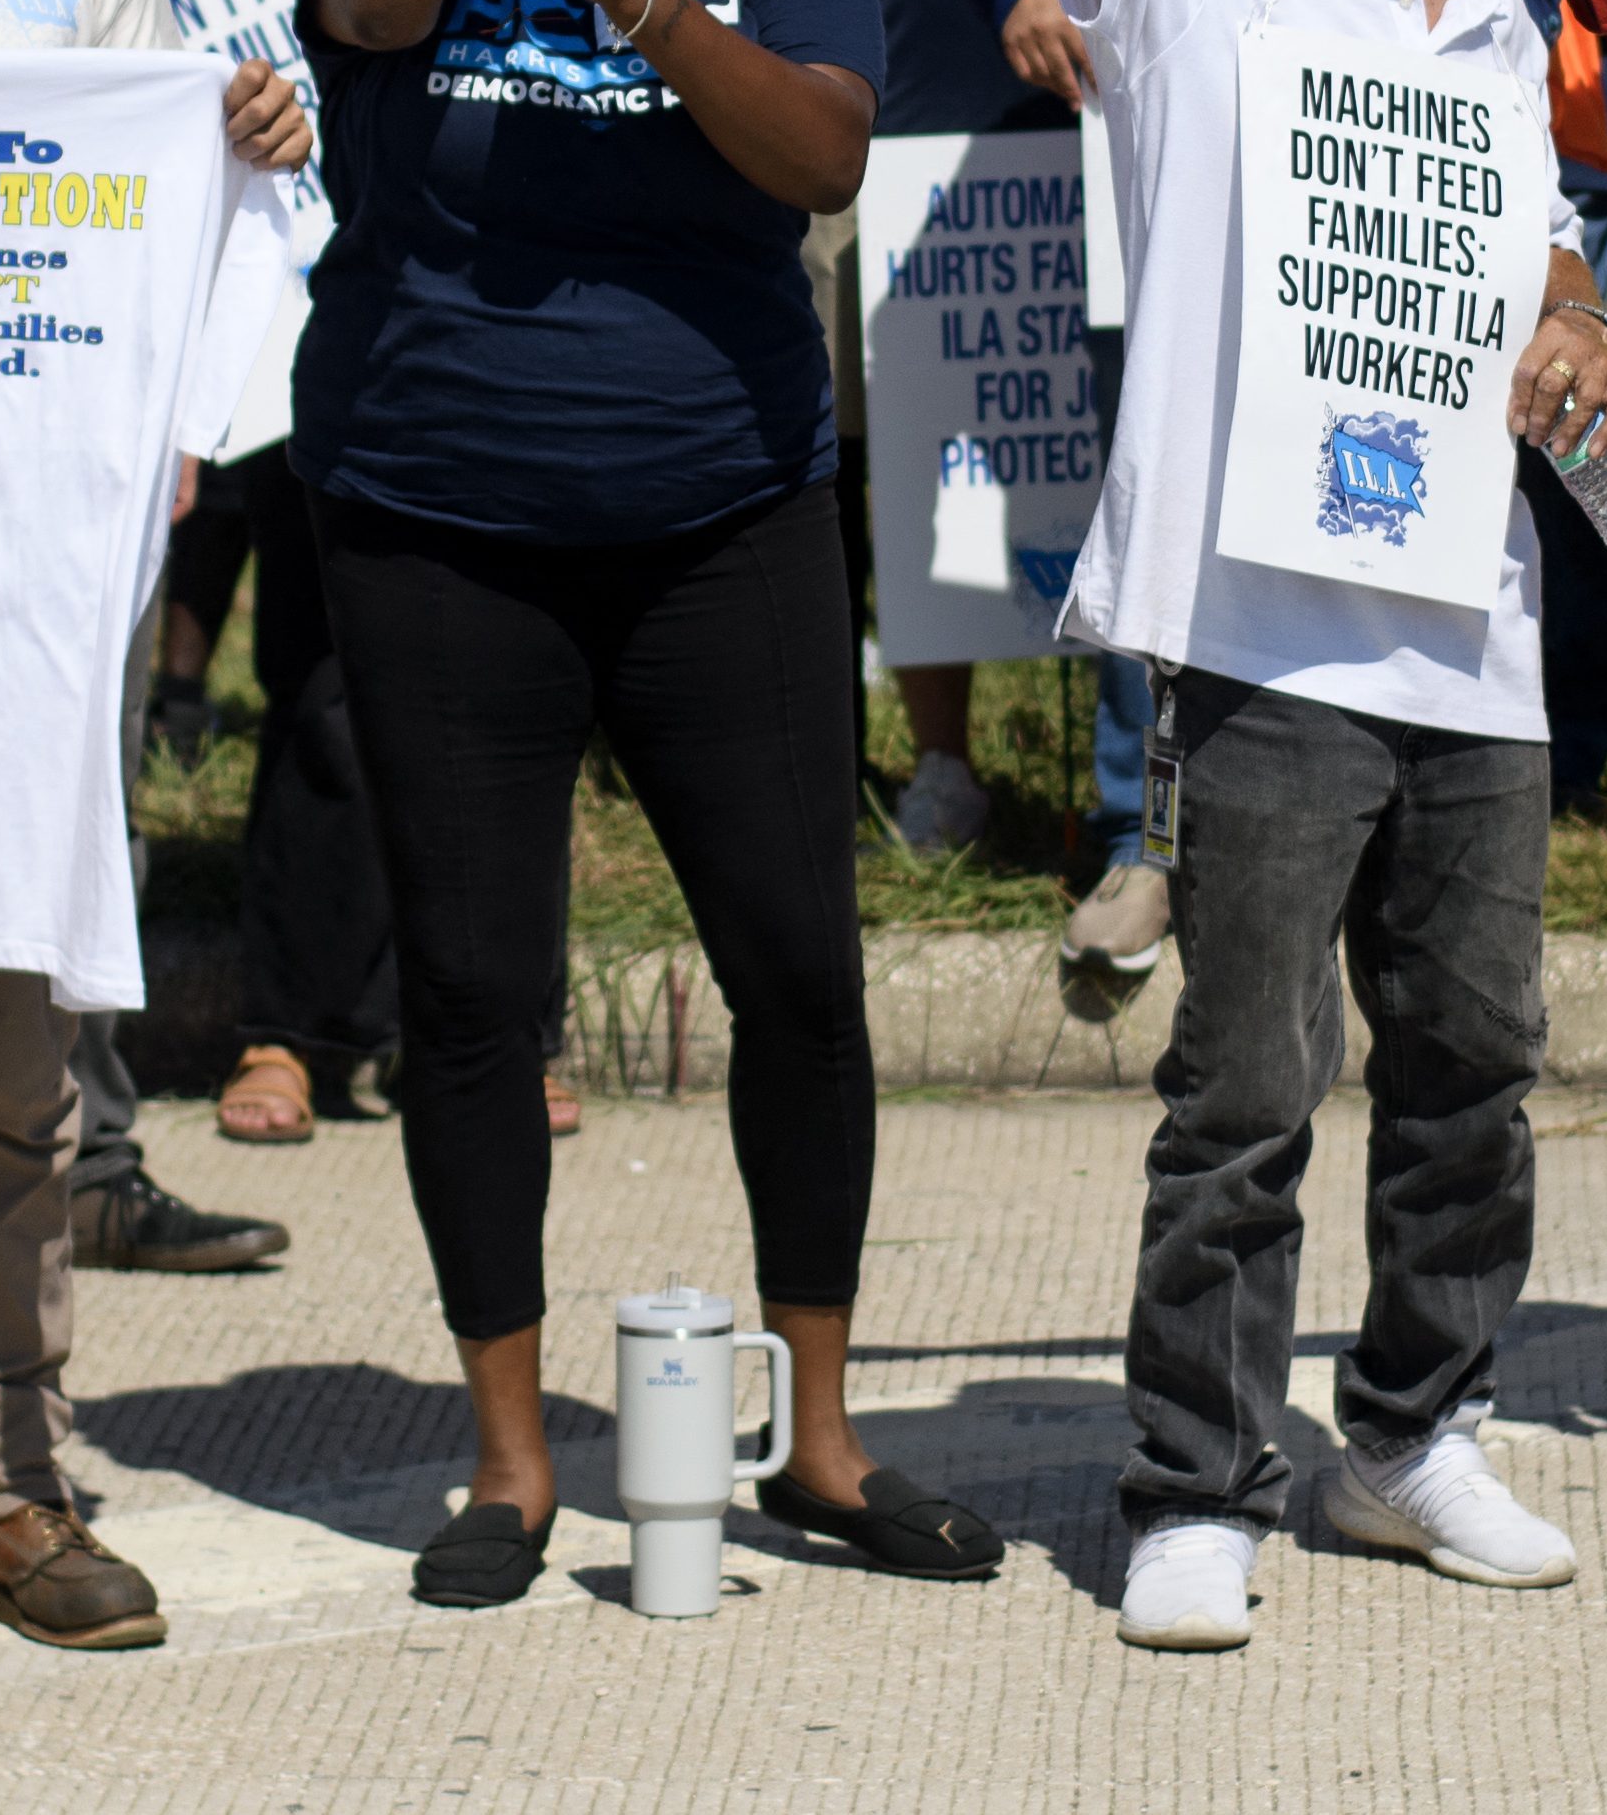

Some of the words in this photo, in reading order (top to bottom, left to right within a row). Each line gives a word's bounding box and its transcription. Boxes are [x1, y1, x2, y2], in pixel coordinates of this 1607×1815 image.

[449, 43, 582, 84] HARRIS
[427, 72, 650, 115] DEMOCRATIC
[1301, 67, 1492, 154] MACHINES
[1290, 128, 1408, 207] DON'T
[1417, 148, 1504, 220] FEED
[926, 175, 1086, 233] AUTOMA
[1306, 195, 1488, 282] FAMILIES:
[887, 241, 1017, 299] HURTS
[942, 308, 1004, 360] ILA
[1017, 304, 1090, 357] STA
[1277, 255, 1447, 331] SUPPORT
[1454, 291, 1506, 353] ILA
[1302, 322, 1472, 411] WORKERS
[976, 370, 1053, 422] FOR
[939, 432, 1102, 488] PROTEC
[1344, 446, 1408, 502] I.L.A.
